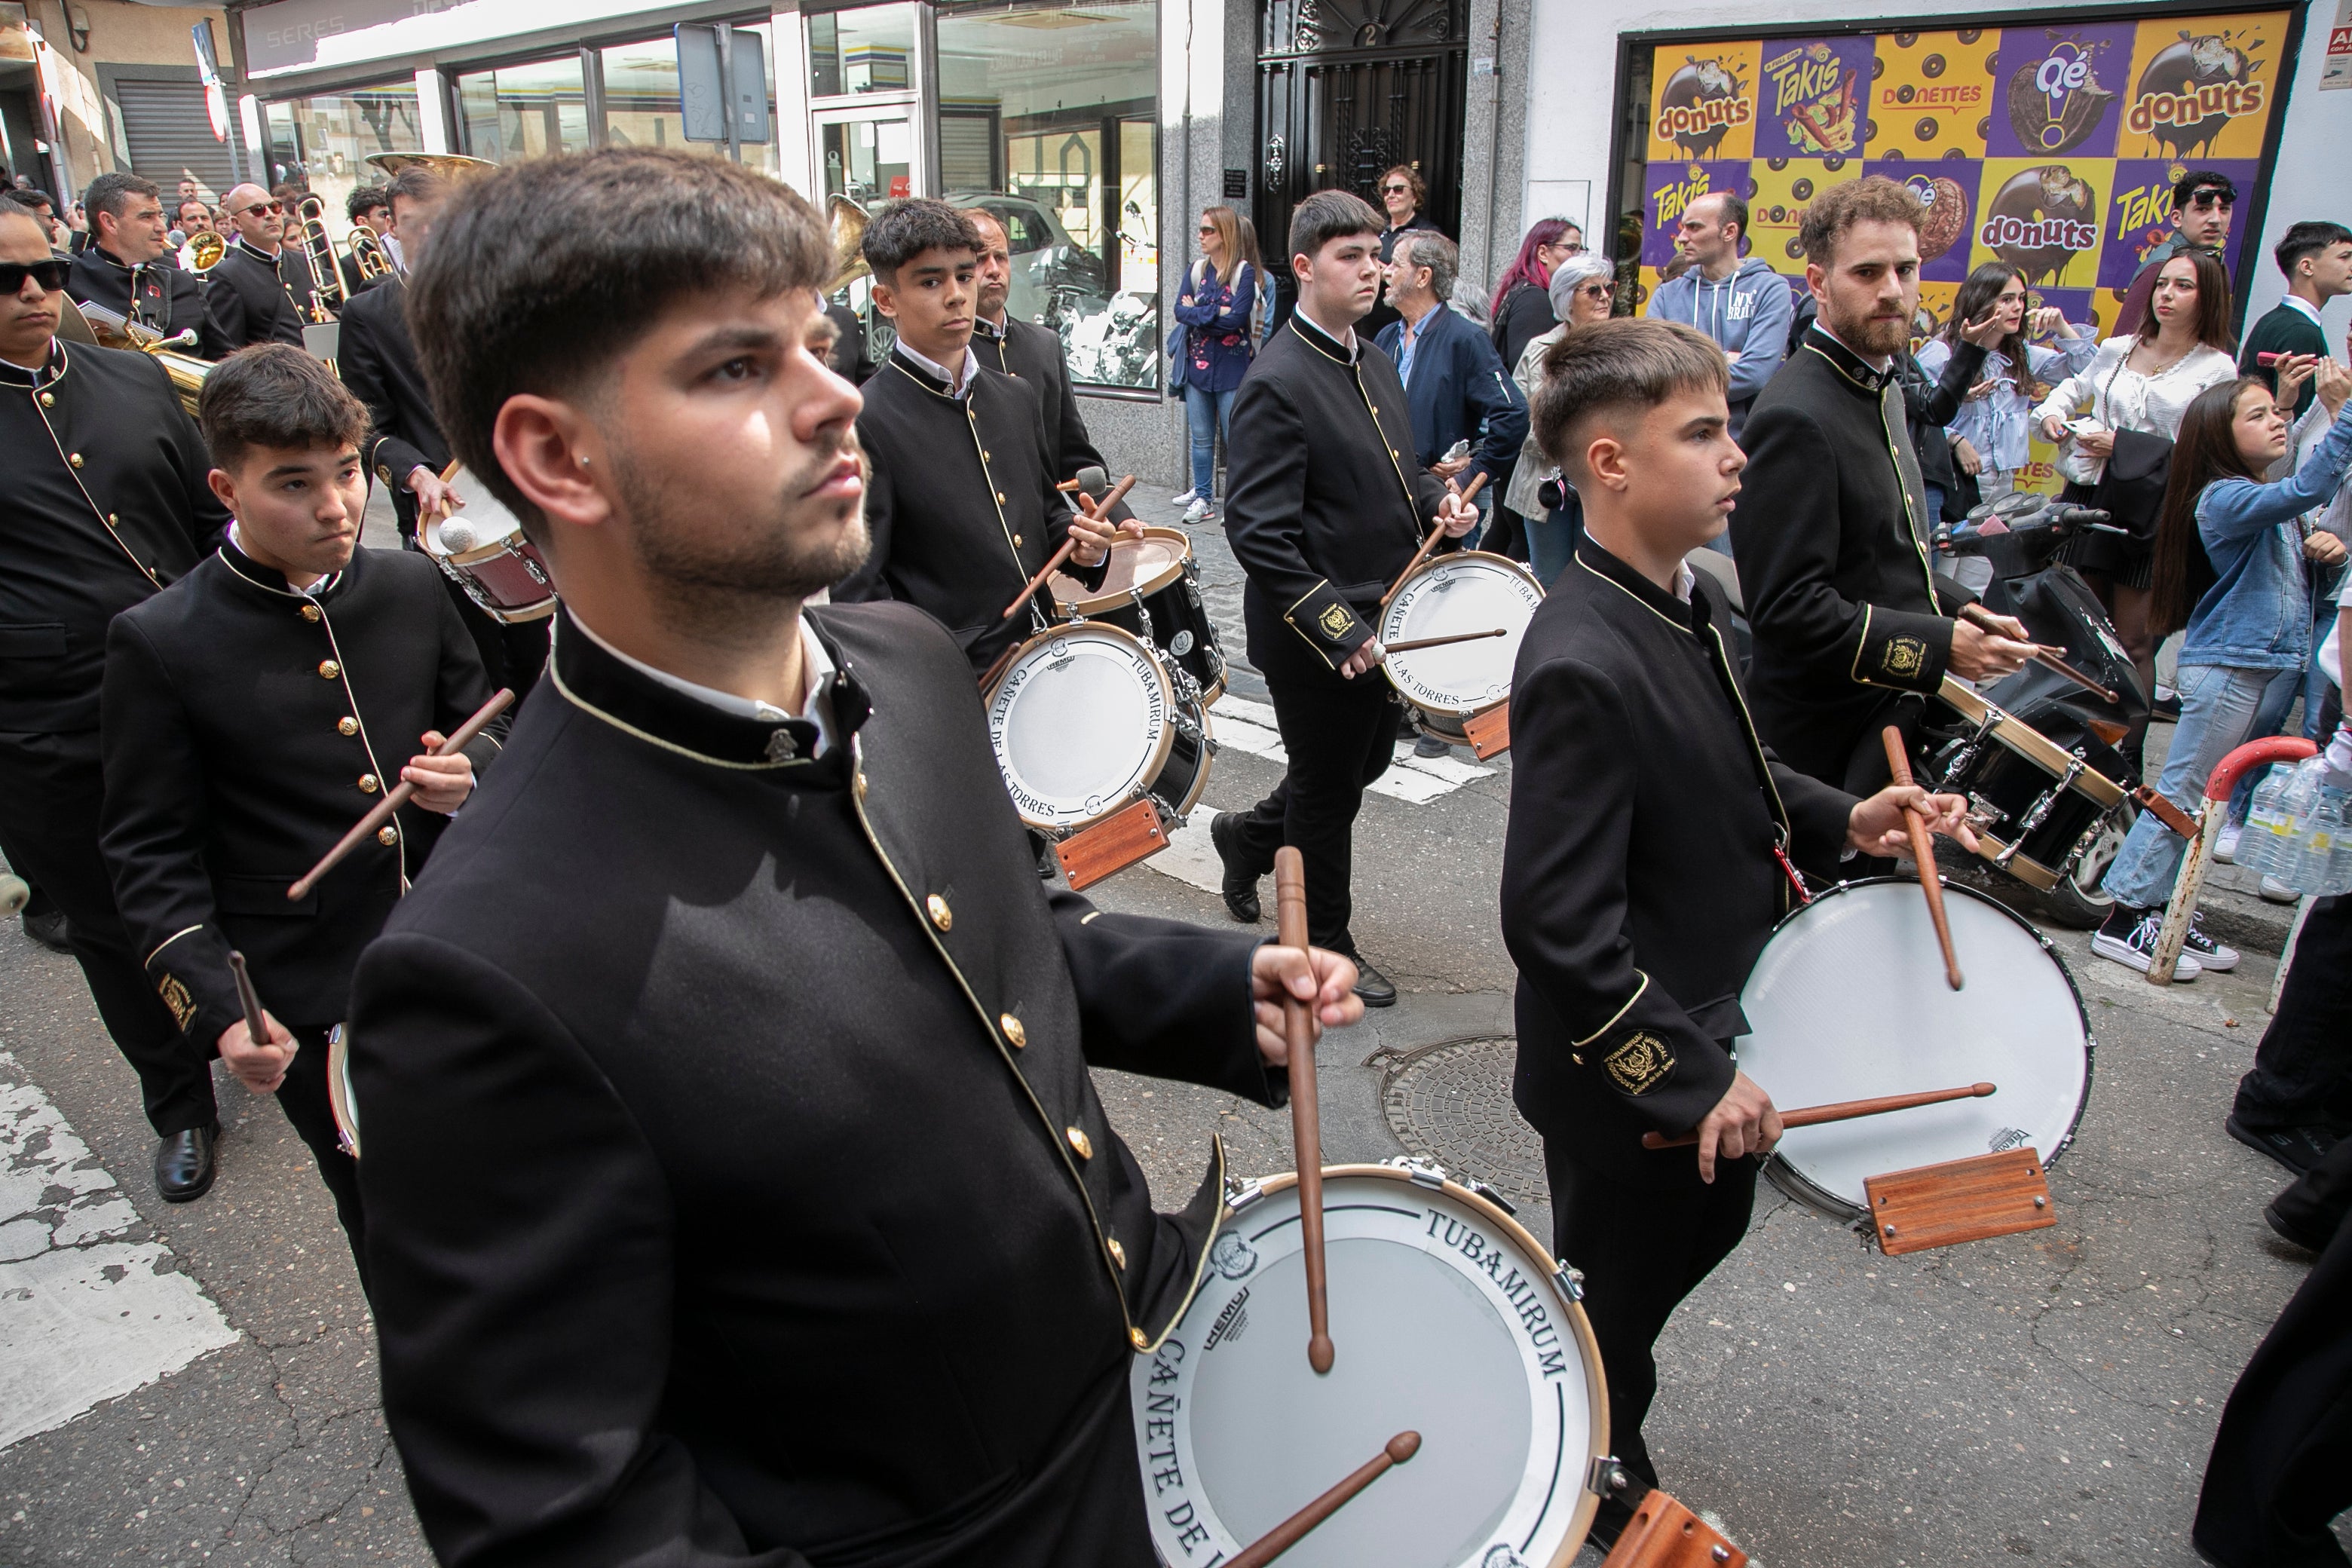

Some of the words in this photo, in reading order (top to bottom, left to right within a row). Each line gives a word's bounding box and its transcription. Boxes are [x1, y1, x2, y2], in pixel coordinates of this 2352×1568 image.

[267, 16, 345, 48] SERES
[1364, 25, 1376, 46] 2
[1772, 57, 1786, 68] FULL
[1882, 84, 1982, 105] DONETTES
[2129, 81, 2263, 133] donuts
[1657, 97, 1752, 141] donuts
[1980, 216, 2097, 250] donuts
[1389, 593, 1414, 639] CAÑETE
[1394, 660, 1413, 684] LAS
[992, 669, 1027, 725] CAÑETE
[1132, 655, 1161, 740] TUBAMIRUM
[1413, 681, 1459, 706] TORRES
[1009, 782, 1055, 817] TORRES
[1644, 1037, 1668, 1060] MUSICAL
[1426, 1208, 1568, 1381] TUBAMIRUM
[1146, 1339, 1186, 1498] CAÑETE
[1165, 1499, 1210, 1558] DE
